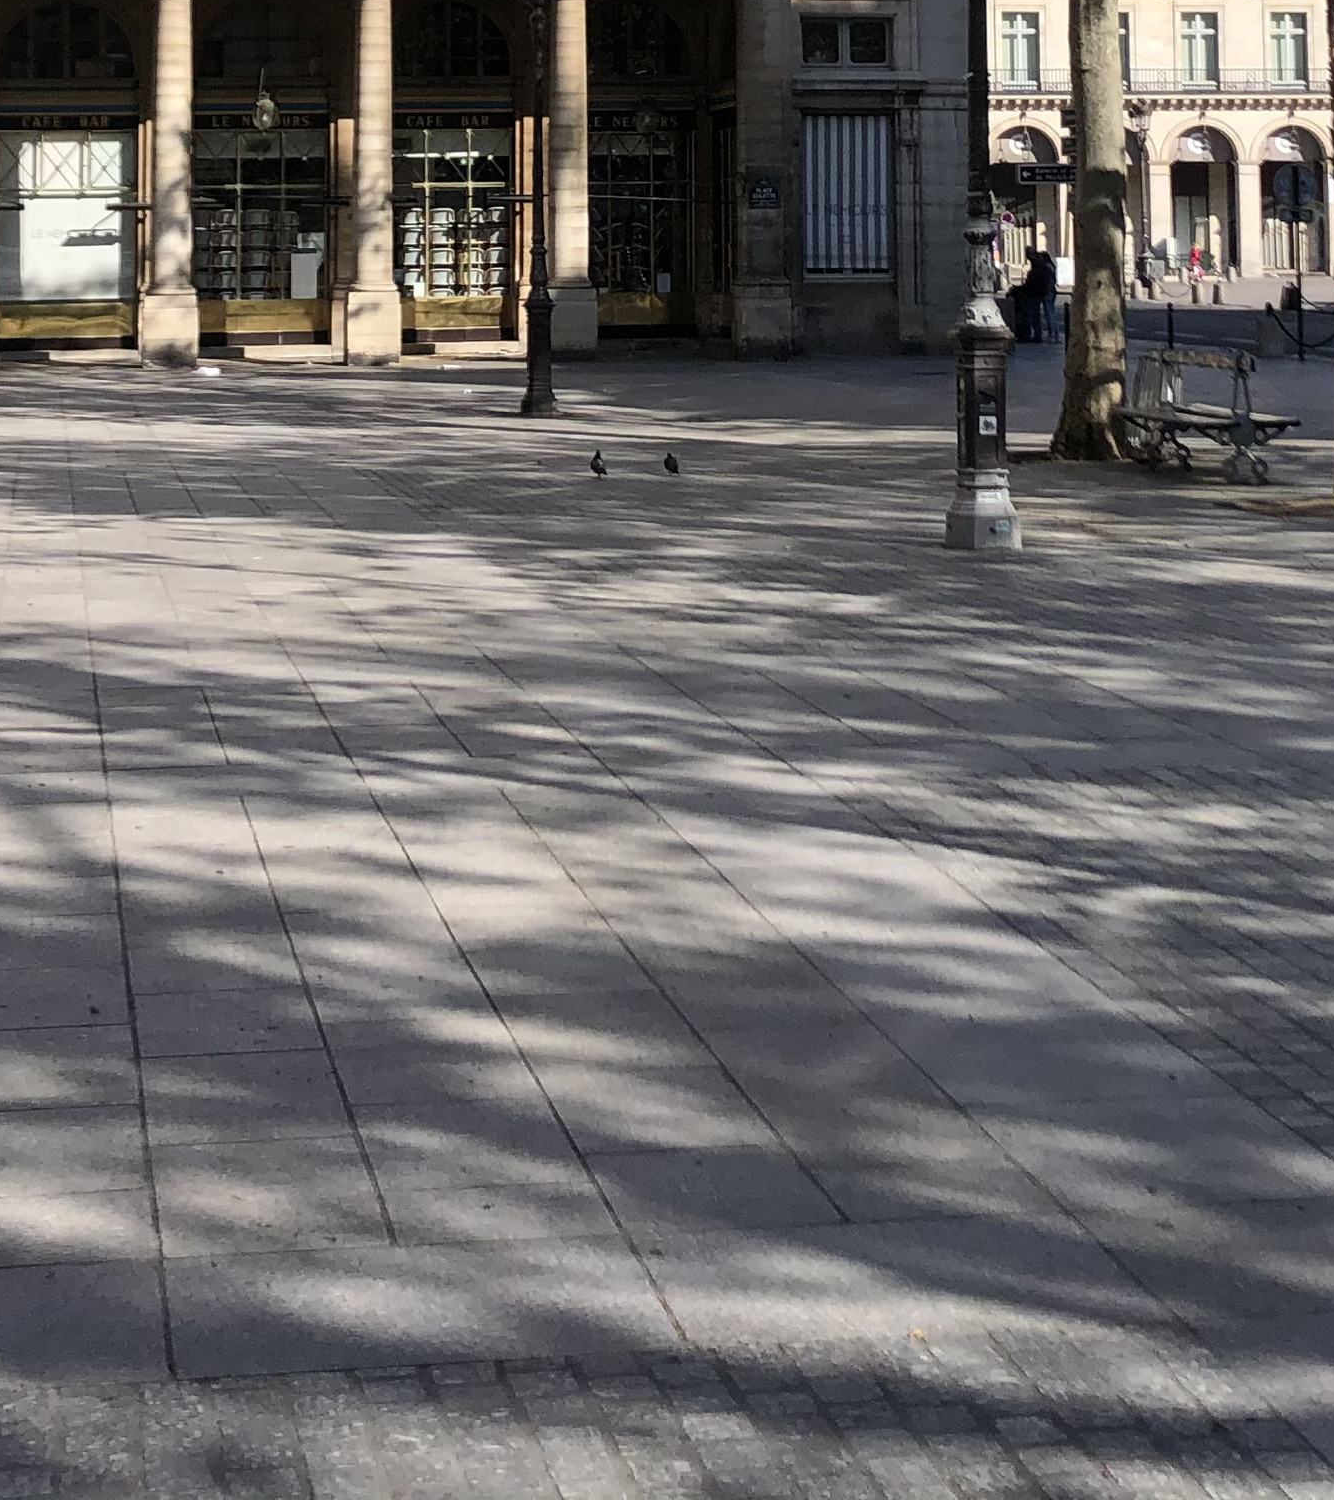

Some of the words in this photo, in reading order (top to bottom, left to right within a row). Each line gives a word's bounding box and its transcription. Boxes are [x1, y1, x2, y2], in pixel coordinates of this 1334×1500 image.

[79, 115, 109, 128] BAR
[211, 115, 232, 128] LE
[460, 115, 490, 127] BAR
